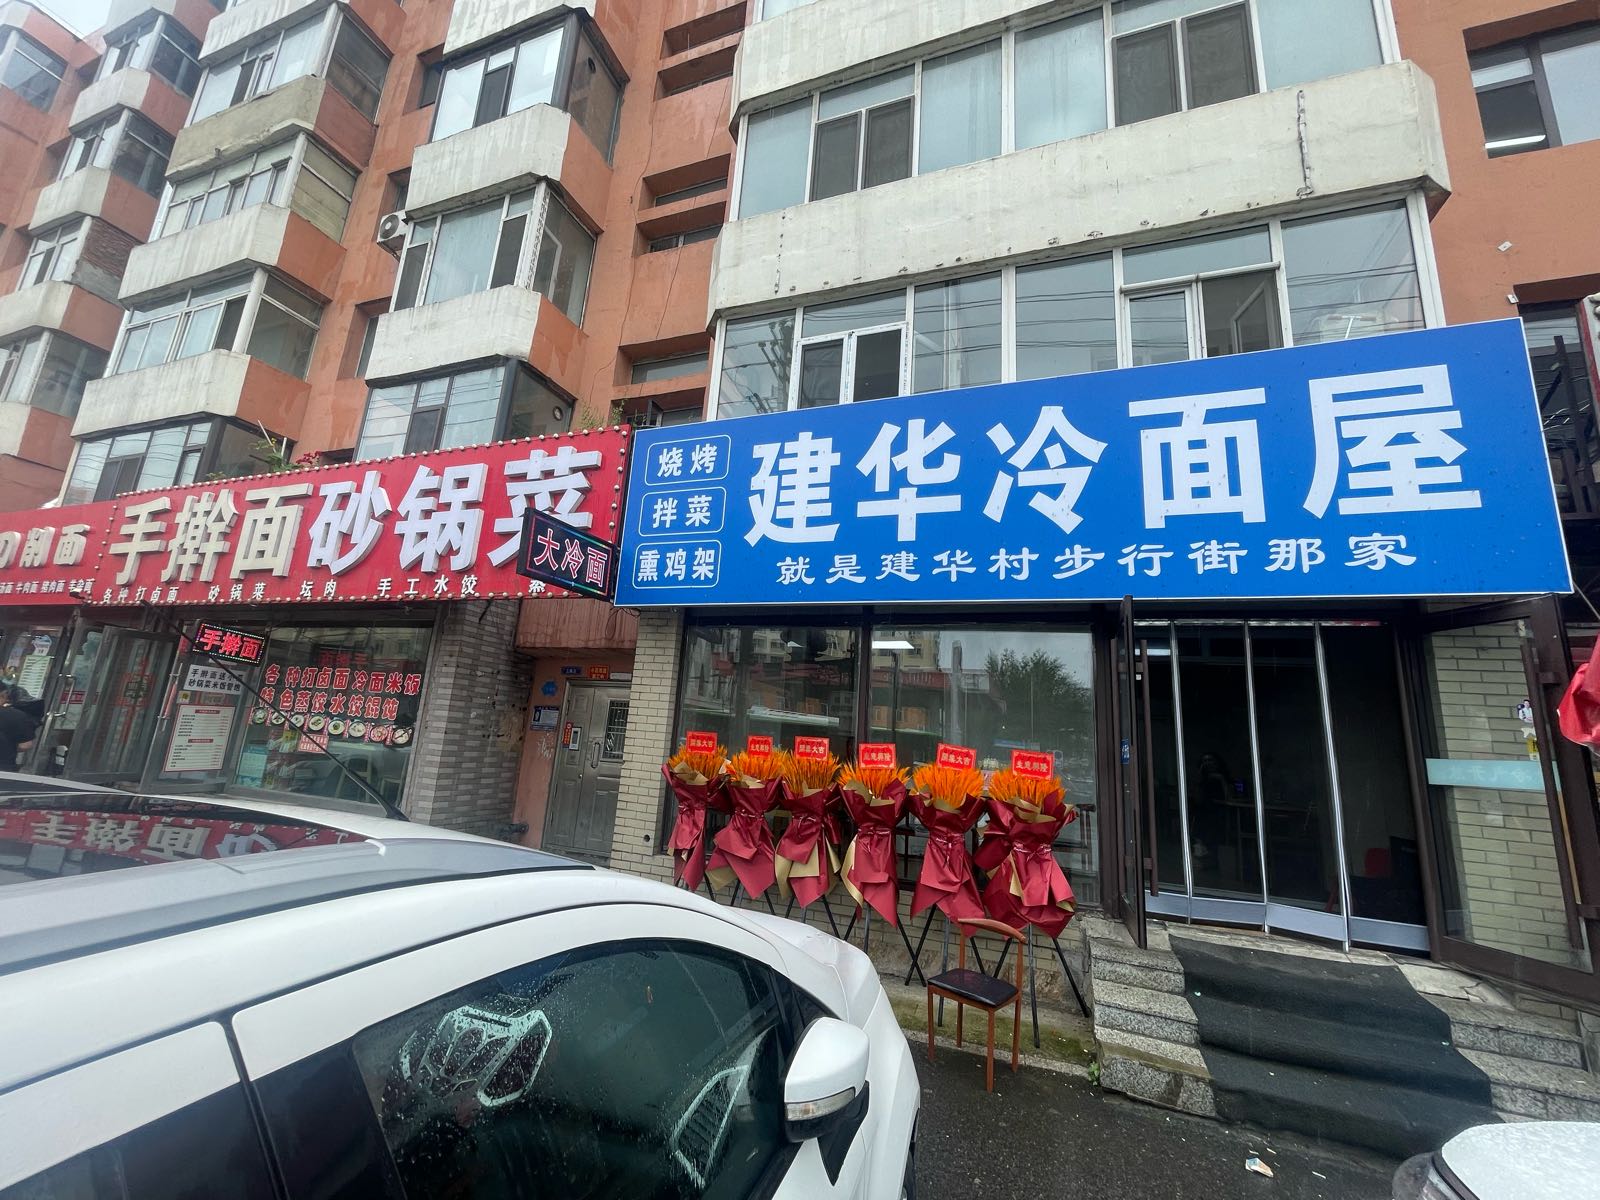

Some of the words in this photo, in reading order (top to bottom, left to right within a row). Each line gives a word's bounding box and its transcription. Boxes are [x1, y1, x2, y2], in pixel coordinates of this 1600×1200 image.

[657, 444, 718, 479] 烧烤
[744, 364, 1482, 548] 建华冷面屋
[652, 495, 713, 529] 拌菜
[533, 527, 608, 588] 大冷面
[637, 548, 716, 582] 熏鸡架
[776, 532, 1417, 583] 就是建华村步行街那家
[103, 585, 179, 603] 各种打卤面
[207, 582, 266, 601] 砂锅菜
[300, 579, 338, 598] 坛肉
[377, 574, 479, 596] 手工水饺
[200, 628, 262, 660] 手擀面
